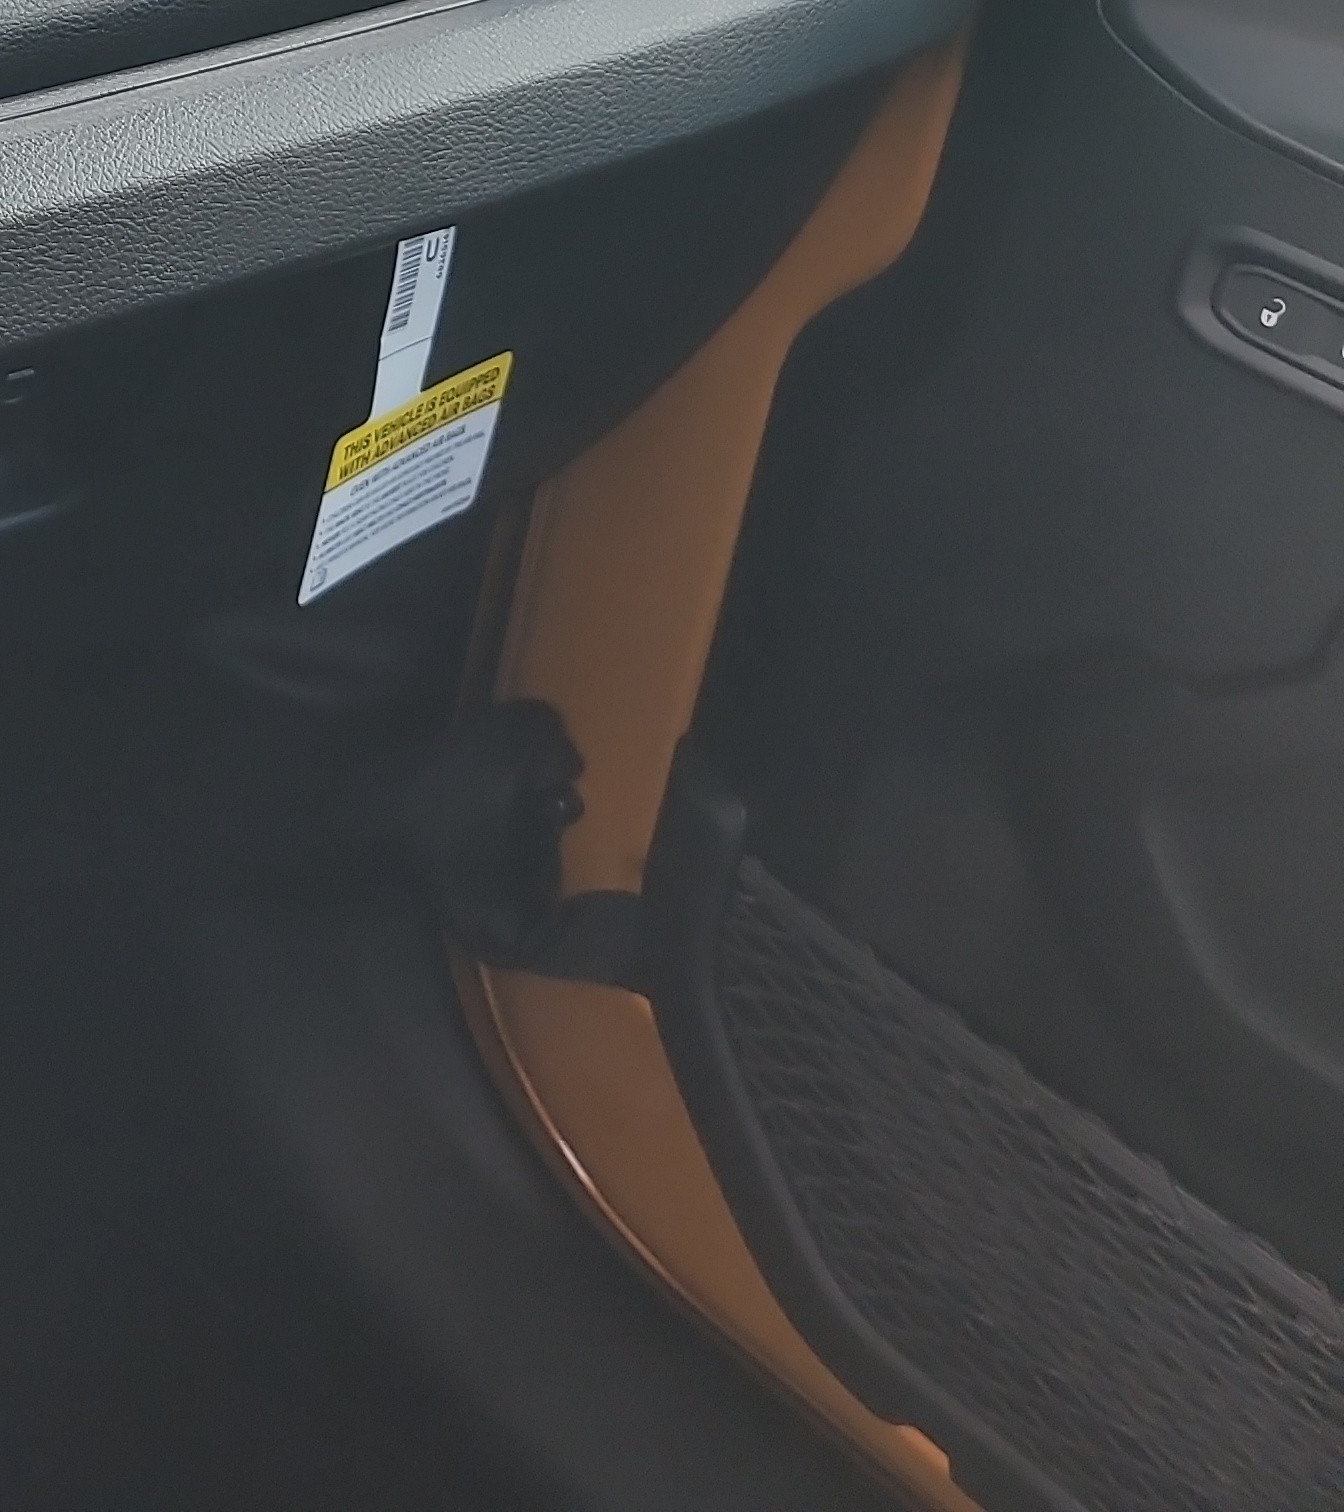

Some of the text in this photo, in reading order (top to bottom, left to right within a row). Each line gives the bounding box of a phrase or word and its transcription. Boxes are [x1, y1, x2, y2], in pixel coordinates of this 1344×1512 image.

[338, 453, 371, 481] WITH
[372, 413, 438, 460] ADVANCED
[440, 401, 461, 421] AIR
[343, 433, 372, 461] THIS
[374, 403, 424, 441] VEHICLE
[424, 396, 438, 414] IS
